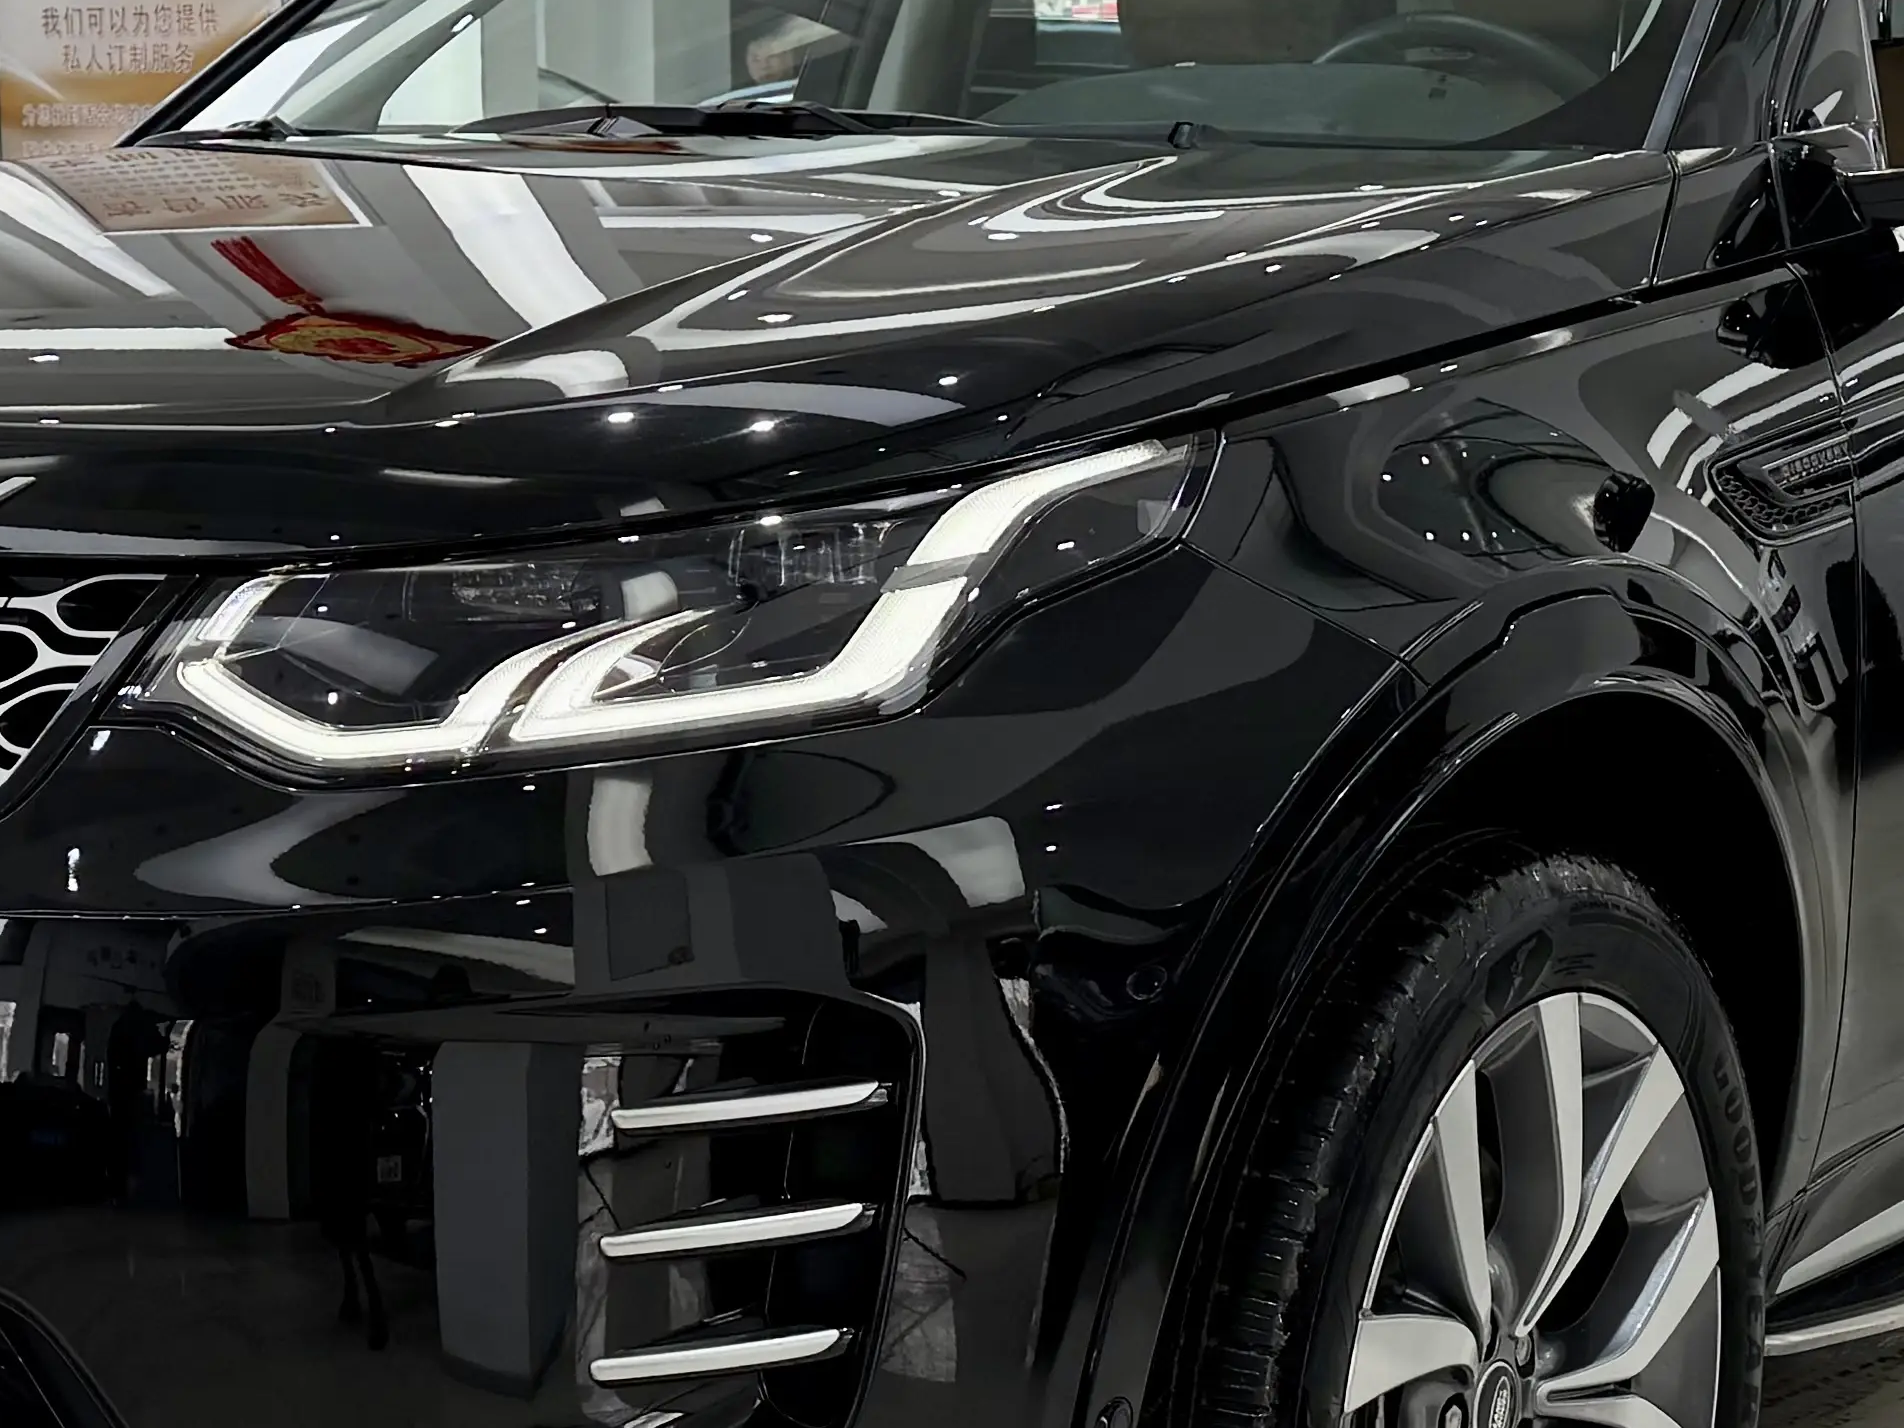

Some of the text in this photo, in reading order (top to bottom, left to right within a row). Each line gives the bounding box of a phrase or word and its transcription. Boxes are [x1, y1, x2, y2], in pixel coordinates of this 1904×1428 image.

[41, 3, 220, 39] 我们可以为您提供
[62, 43, 194, 74] 私人订制服务
